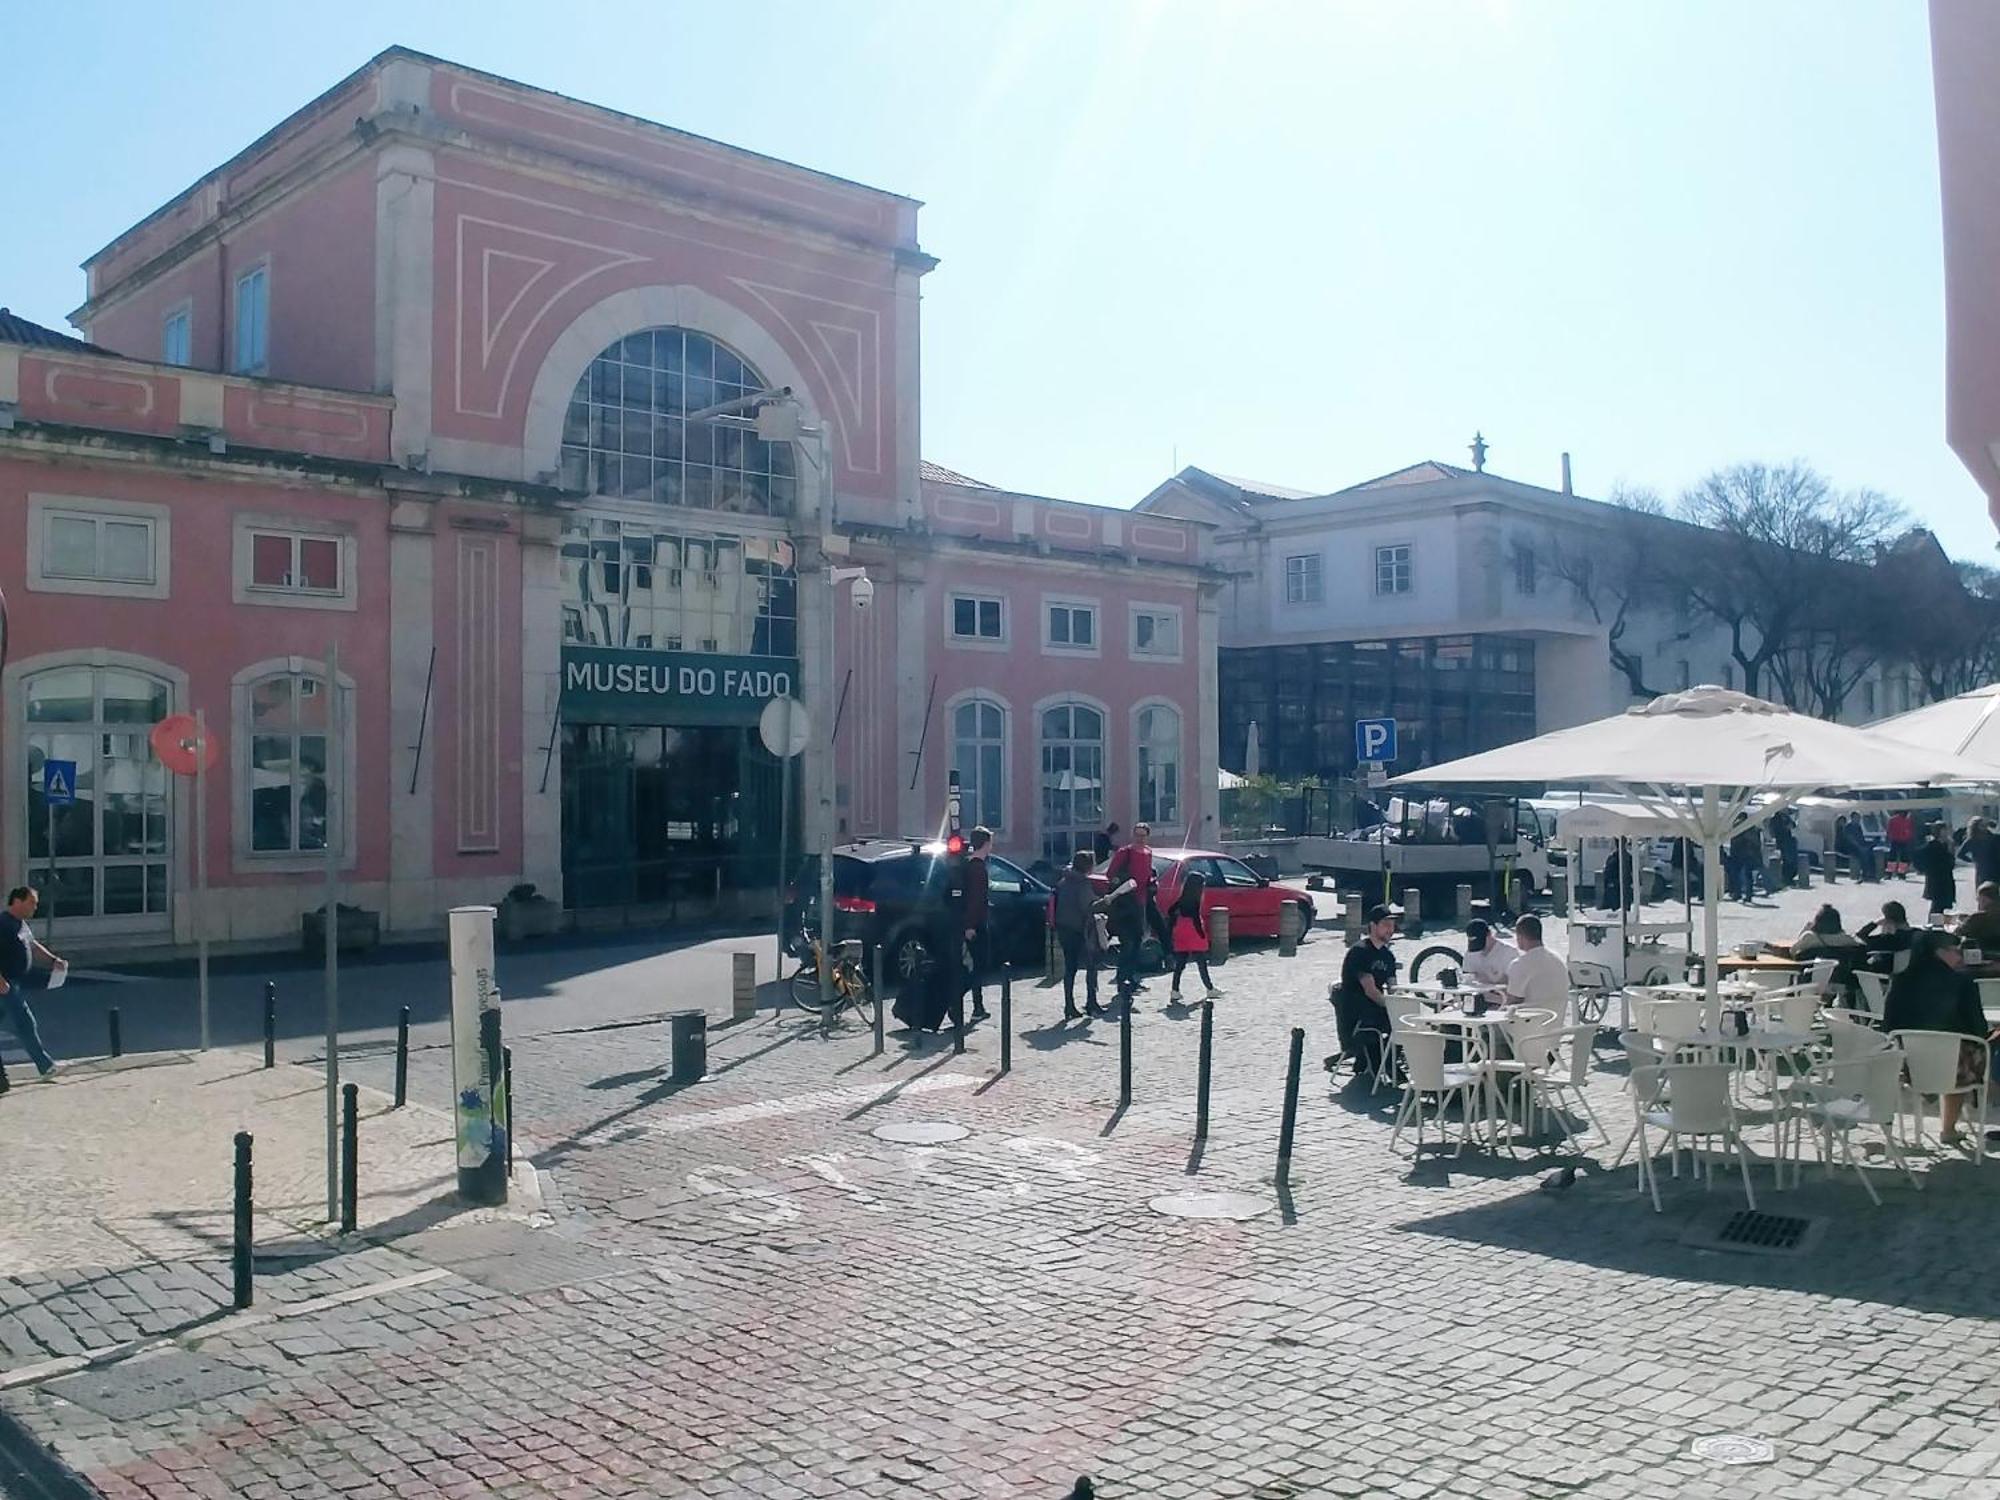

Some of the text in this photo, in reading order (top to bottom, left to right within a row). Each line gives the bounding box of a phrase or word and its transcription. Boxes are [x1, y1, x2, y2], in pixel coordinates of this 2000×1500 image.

[567, 662, 790, 698] MUSEU DO FADO
[1365, 724, 1387, 758] P
